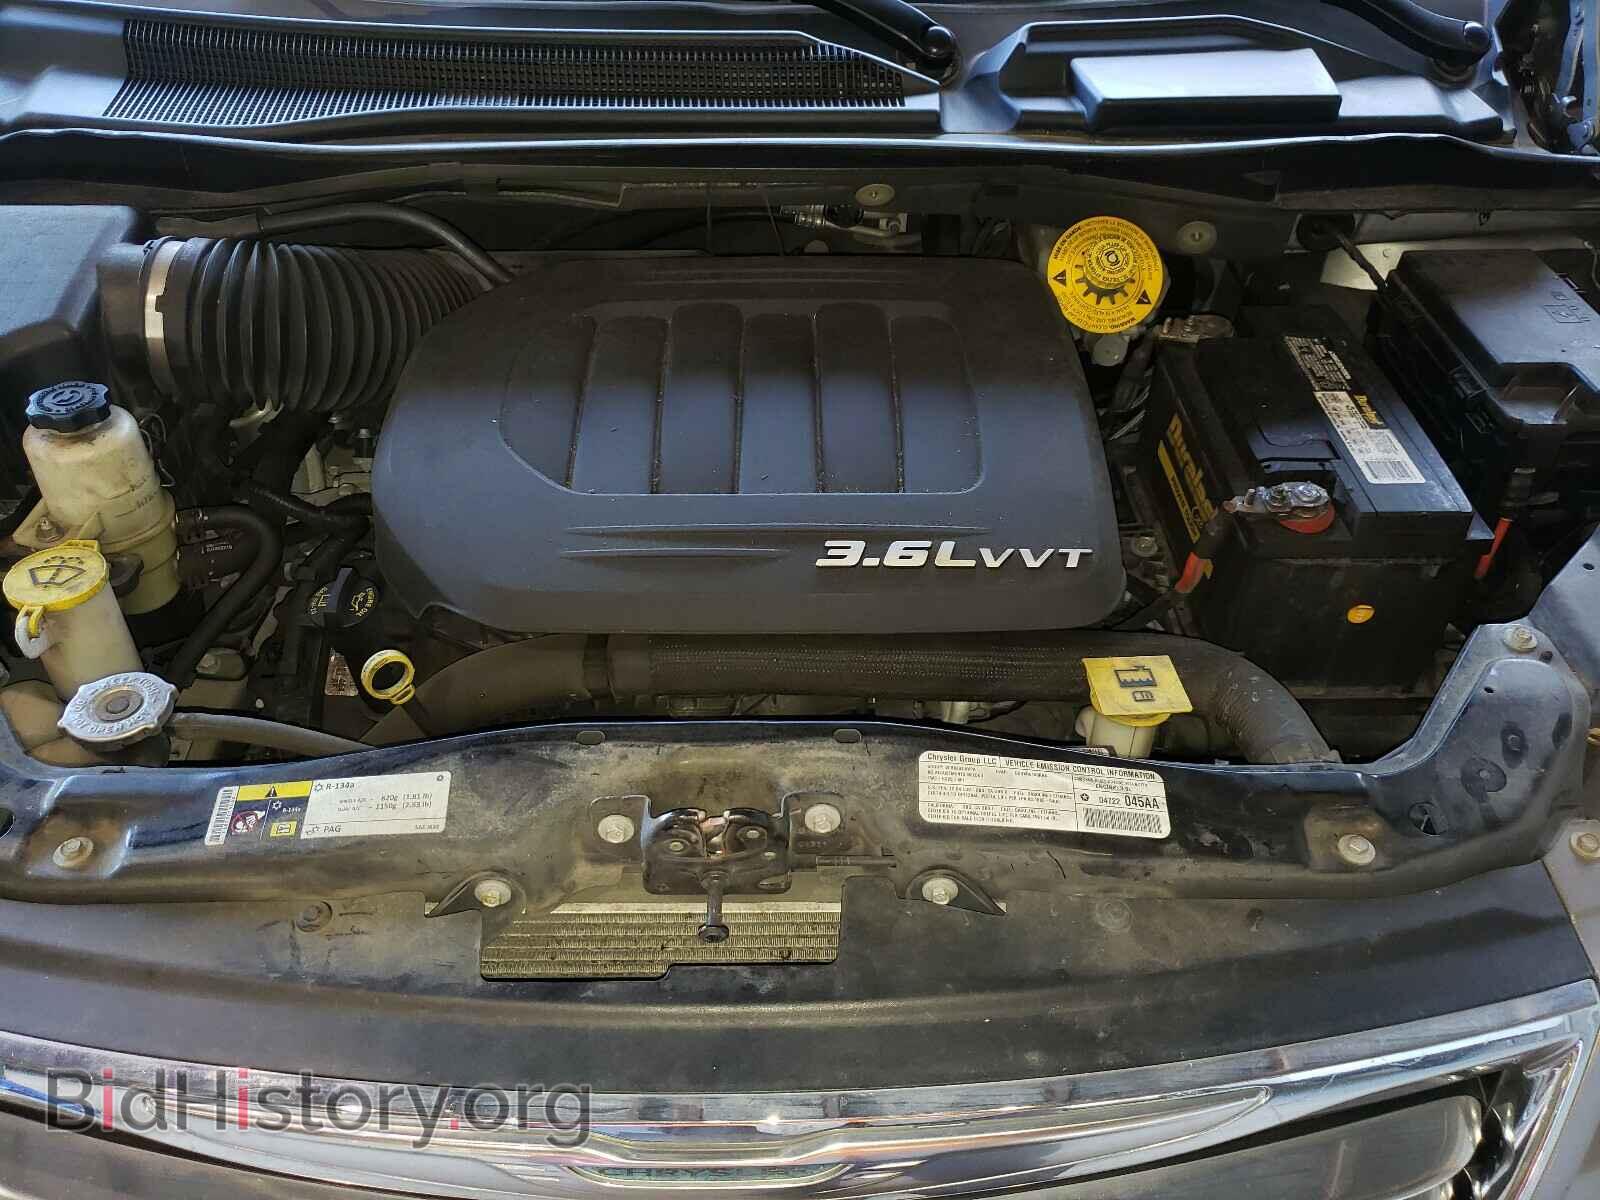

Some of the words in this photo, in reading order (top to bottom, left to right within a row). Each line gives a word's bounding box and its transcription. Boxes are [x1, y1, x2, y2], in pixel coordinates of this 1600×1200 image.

[815, 540, 977, 567] 3.6L
[978, 547, 1094, 568] VVT
[927, 753, 957, 762] Chrysler
[959, 755, 981, 764] Group
[983, 757, 998, 765] LLC
[1005, 759, 1035, 769] VEHICLE
[1036, 761, 1070, 772] EMISSION
[1072, 765, 1104, 775] CONTROL
[1106, 768, 1155, 780] INFORMATION
[325, 782, 355, 790] R-134a
[1098, 796, 1121, 806] 04722
[1124, 794, 1160, 810] 045AA
[323, 824, 342, 833] PAG
